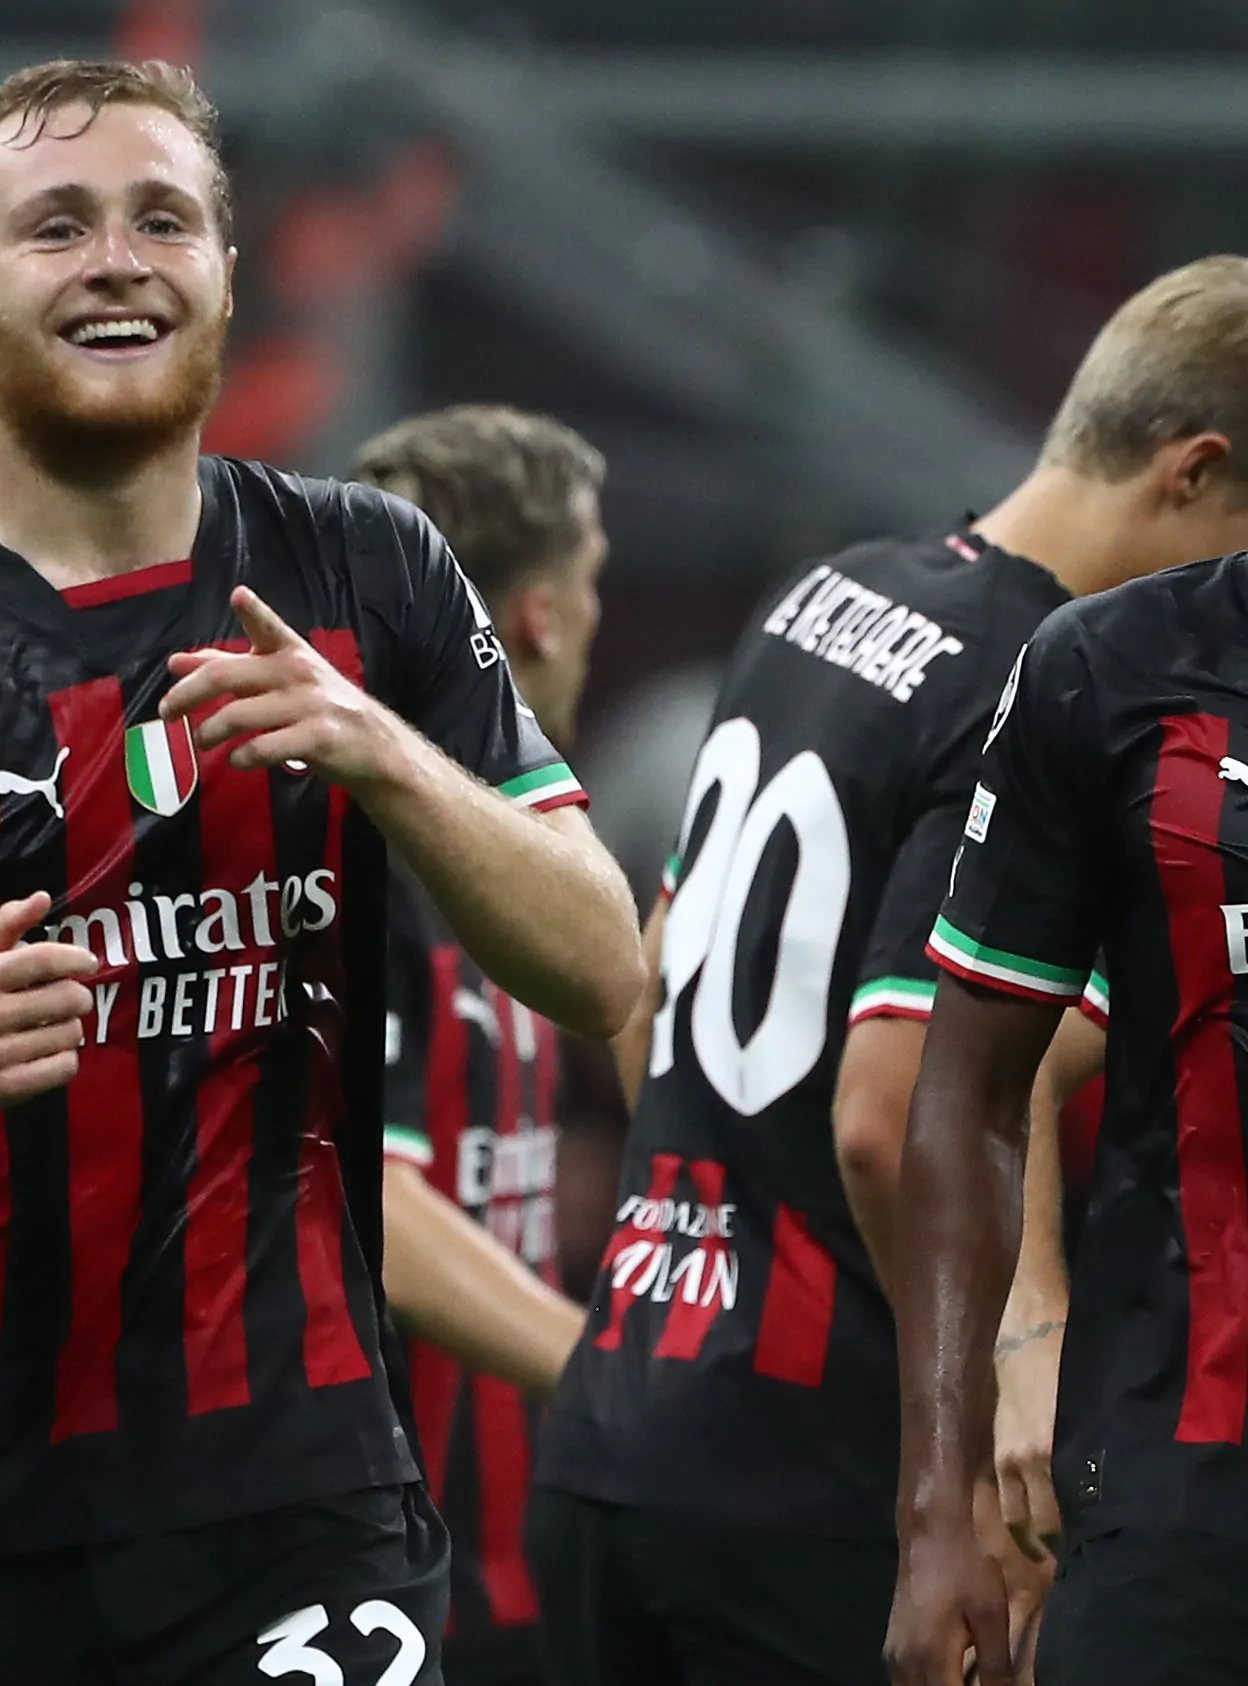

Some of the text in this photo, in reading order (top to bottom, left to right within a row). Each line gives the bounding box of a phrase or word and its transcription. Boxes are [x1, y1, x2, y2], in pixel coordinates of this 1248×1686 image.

[14, 868, 336, 967] mirates
[650, 716, 851, 1117] 90
[256, 1599, 427, 1686] 32
